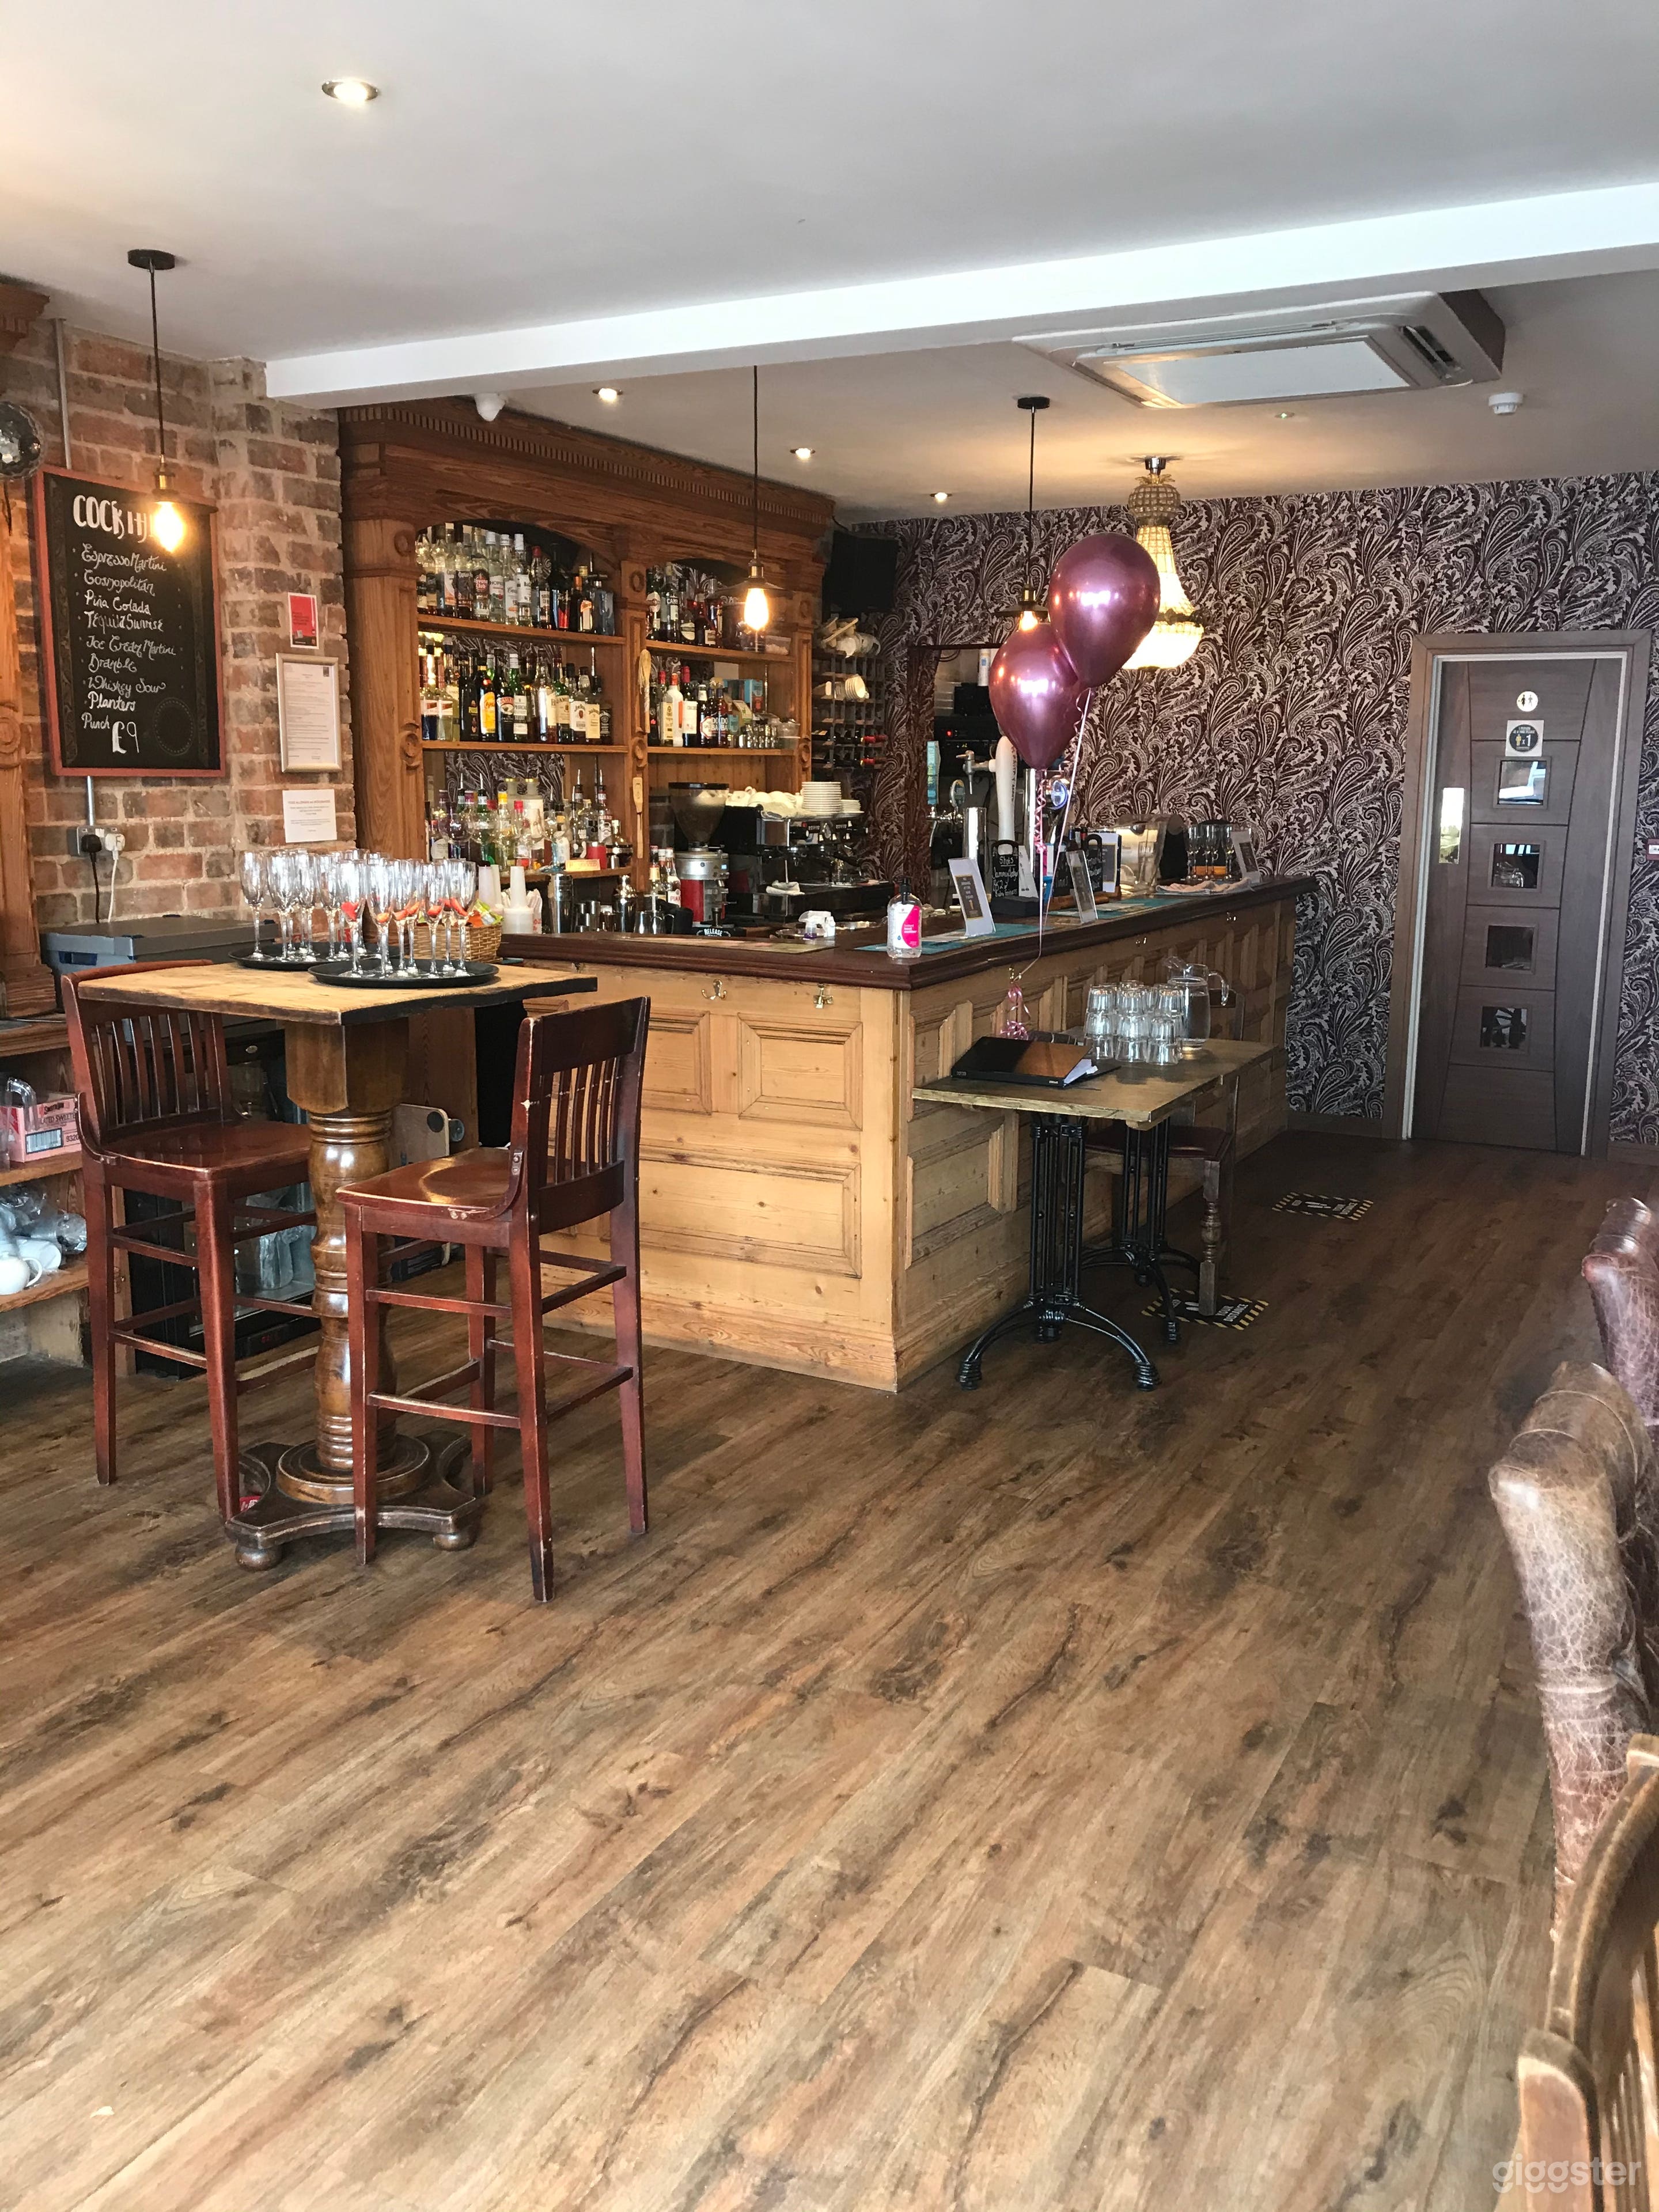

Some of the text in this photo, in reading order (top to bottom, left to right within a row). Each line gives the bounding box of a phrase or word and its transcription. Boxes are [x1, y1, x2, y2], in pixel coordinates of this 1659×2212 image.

[81, 543, 167, 573] Espresso Martini
[113, 597, 151, 616] Colada
[84, 611, 164, 634] Tequila Sunrise
[86, 635, 176, 661] Ice Cream Martini
[88, 653, 137, 673] Bramble
[88, 675, 166, 698] Whiskey Sour
[88, 691, 136, 711] Planters
[81, 712, 110, 729] Punch
[112, 721, 139, 754] £9
[1526, 734, 1531, 747] 1
[703, 928, 723, 937] RELEASE
